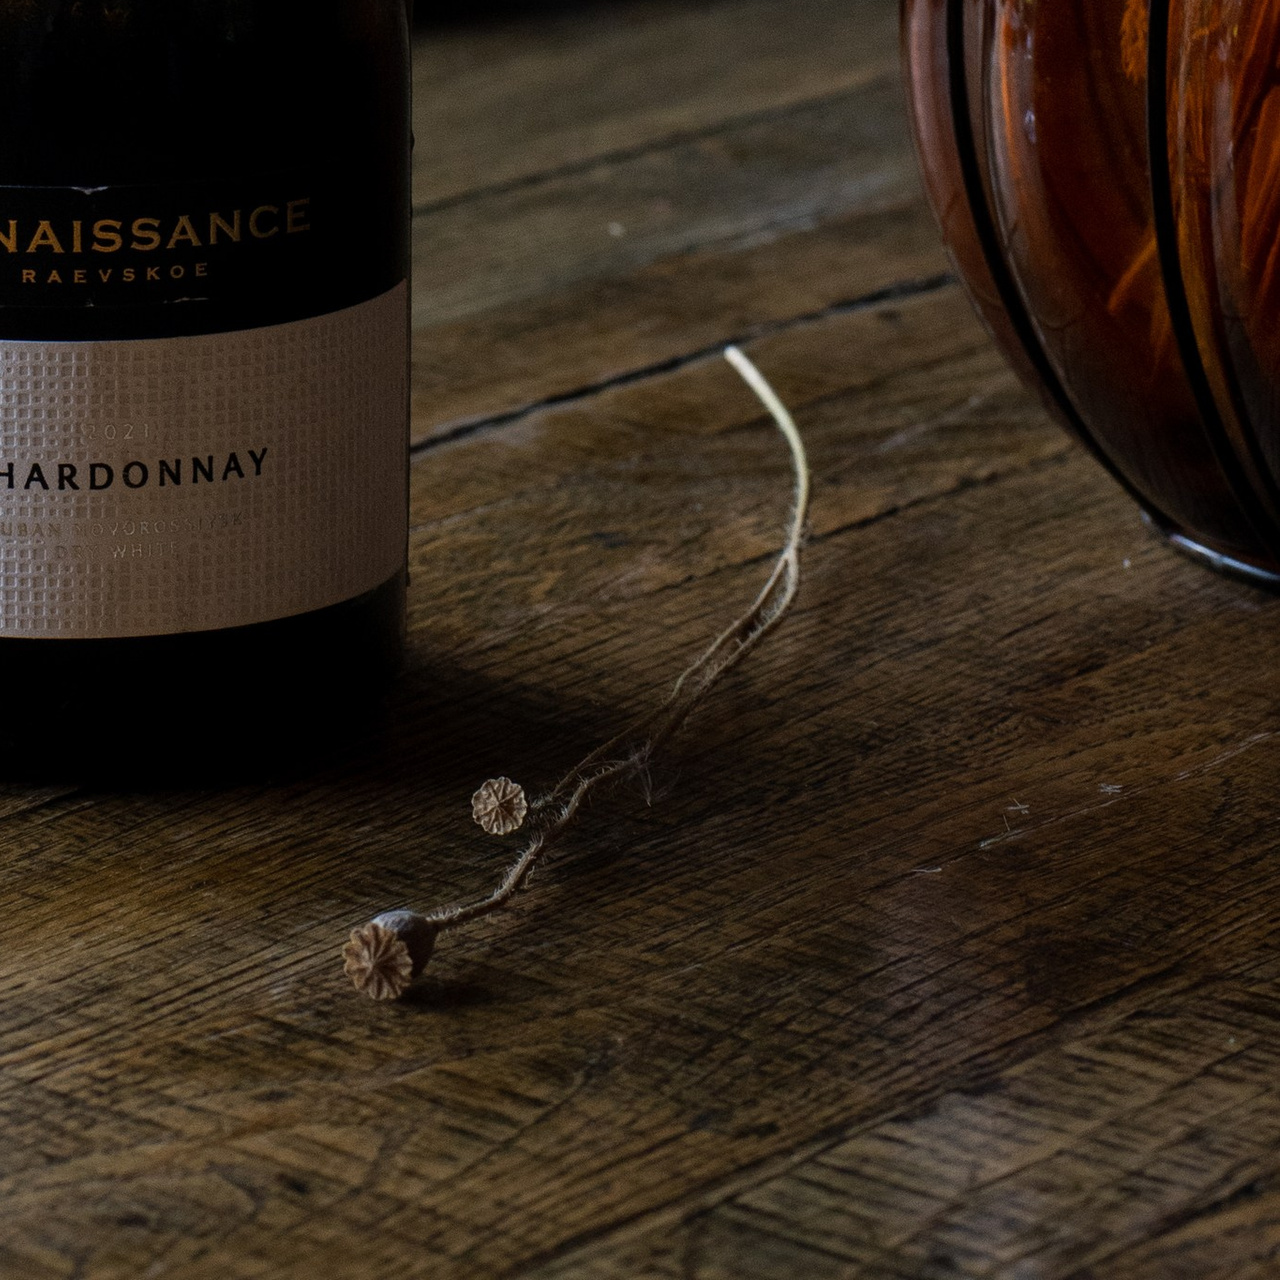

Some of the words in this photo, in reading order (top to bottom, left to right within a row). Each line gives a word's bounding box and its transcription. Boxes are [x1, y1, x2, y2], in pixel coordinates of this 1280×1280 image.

[21, 261, 209, 285] RAEVSKOE
[86, 423, 150, 440] 2021
[112, 541, 181, 559] WHITE
